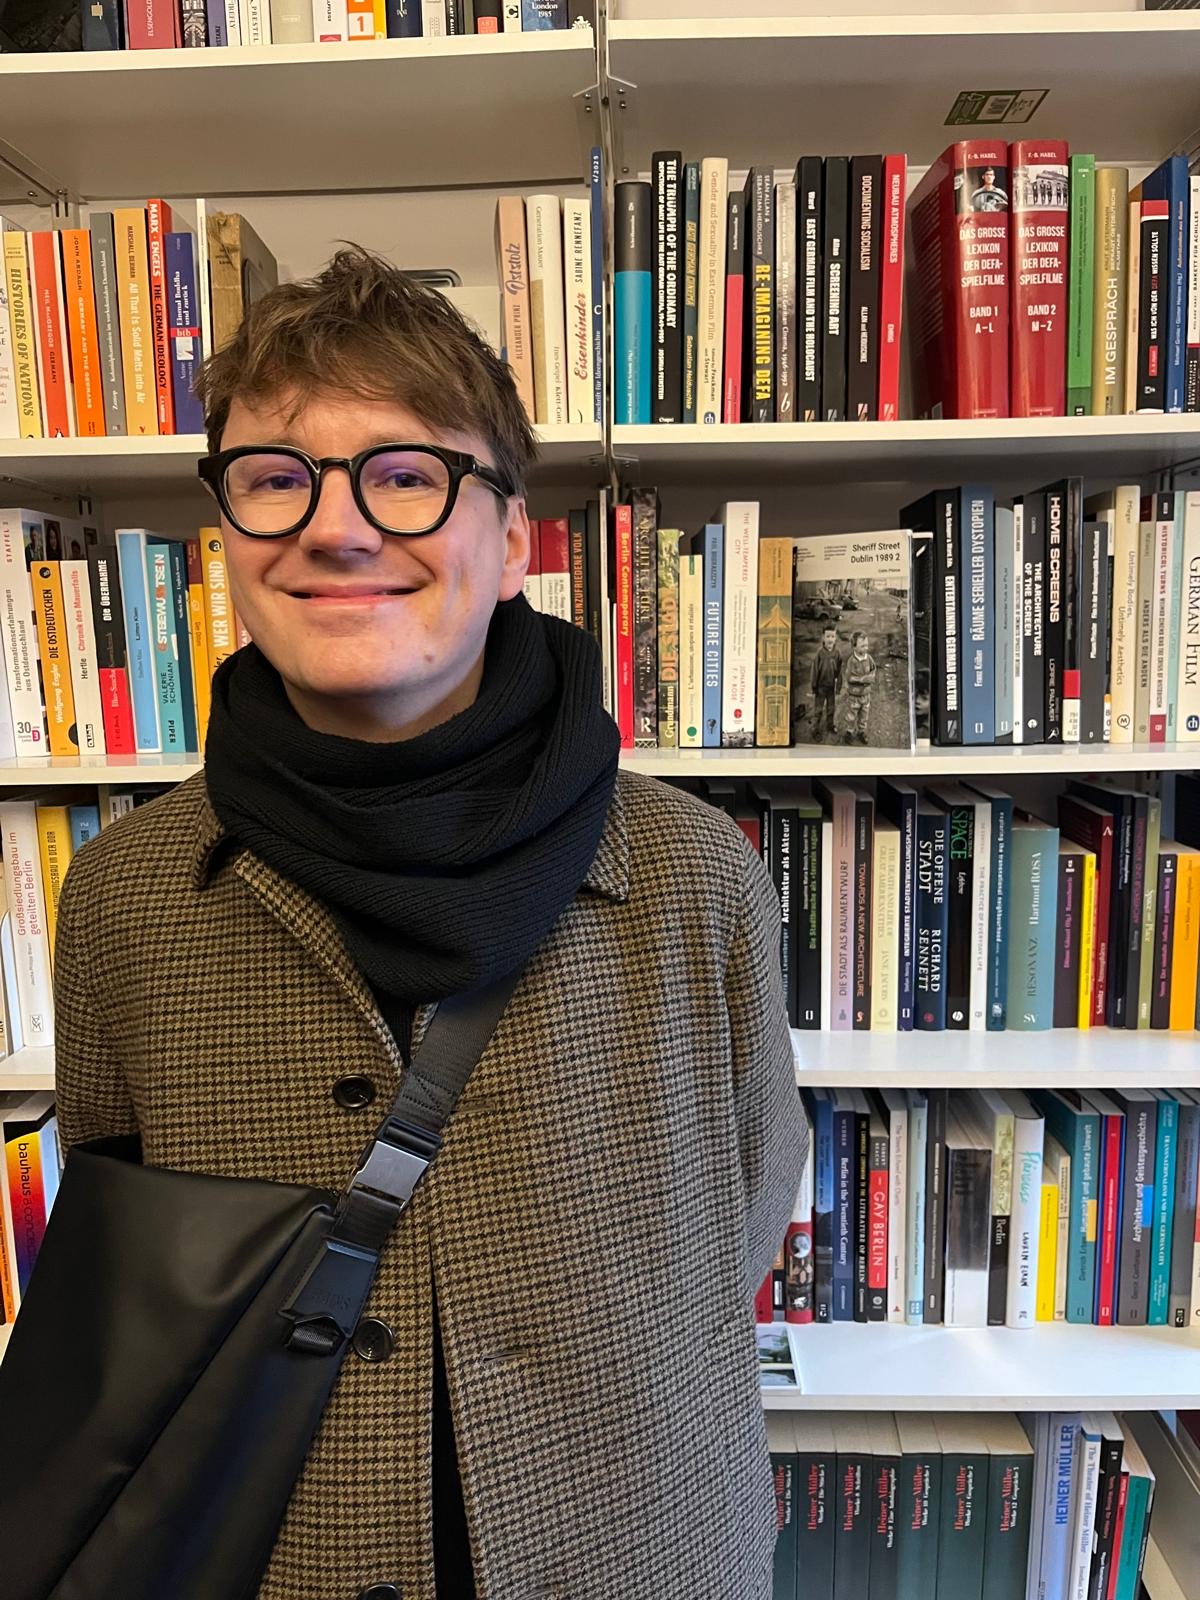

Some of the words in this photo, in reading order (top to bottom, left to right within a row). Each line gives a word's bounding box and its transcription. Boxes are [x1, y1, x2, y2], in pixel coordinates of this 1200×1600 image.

[532, 2, 558, 10] London
[356, 15, 364, 32] 1
[667, 159, 677, 181] THE
[667, 183, 677, 232] TRIUMPH
[807, 191, 816, 209] Ward
[149, 203, 160, 233] MARX
[536, 206, 544, 245] Generation
[805, 218, 816, 239] EAST
[959, 228, 976, 238] DAS
[977, 226, 1006, 238] GROSSE
[1019, 226, 1037, 238] DAS
[1038, 226, 1065, 238] GROSSE
[667, 234, 677, 248] OF
[832, 238, 840, 256] Allan
[967, 243, 1000, 254] LEXIKON
[1026, 241, 1059, 254] LEXIKON
[1151, 231, 1159, 253] SOLLTE
[151, 241, 162, 277] ENGELS
[537, 246, 545, 269] Mauer
[667, 250, 677, 270] THE
[805, 240, 816, 275] GERMAN
[964, 259, 980, 270] DER
[980, 258, 1004, 270] DEFA-
[1022, 258, 1040, 270] DER
[1041, 258, 1063, 270] DEFA-
[1151, 253, 1159, 274] WISSEN
[153, 284, 162, 301] THE
[805, 277, 816, 296] FILM
[829, 263, 840, 315] SCREENING
[961, 274, 1006, 287] SPIELFILME
[1019, 273, 1064, 286] SPIELFILME
[10, 268, 27, 340] HISTORIES
[667, 272, 677, 328] ORDINARY
[805, 297, 815, 315] AND
[970, 306, 991, 318] BAND
[993, 306, 998, 317] 1
[1028, 305, 1048, 317] BAND
[1050, 305, 1057, 316] 2
[155, 303, 165, 343] GERMAN
[755, 264, 771, 366] RE-IMAGINING
[805, 316, 815, 331] THE
[829, 317, 840, 335] ART
[1103, 278, 1118, 362] GESPRÄCH
[1151, 316, 1159, 327] ICH
[1151, 327, 1159, 340] WAS
[17, 342, 28, 359] OF
[805, 333, 815, 382] HOLOCAUST
[157, 344, 168, 389] IDEOLOGY
[1105, 366, 1117, 385] IM
[20, 361, 34, 417] NATIONS
[755, 369, 770, 400] DEFA
[1050, 496, 1061, 544] HOME
[621, 532, 630, 563] Berlin
[850, 555, 874, 564] Dublin
[875, 553, 894, 563] 1989
[895, 553, 900, 562] 2
[852, 543, 877, 553] Sheriff
[877, 542, 901, 552] Street
[208, 561, 226, 589] SIND
[1024, 562, 1032, 575] OF
[1034, 562, 1042, 581] THE
[1125, 550, 1136, 587] Untimely
[70, 570, 83, 609] Mauerfalls
[1024, 577, 1032, 596] THE
[1050, 548, 1061, 623] SCREENS
[1187, 555, 1200, 635] GERMAN
[209, 590, 228, 617] WIR
[620, 565, 631, 637] Contemporary
[944, 575, 956, 636] ENTERTAINING
[1125, 587, 1135, 618] Bodies,
[1142, 599, 1150, 627] ANDERS
[42, 588, 58, 645] OSTDEUTSCHEN
[74, 609, 83, 623] des
[1024, 599, 1032, 637] SCREEN
[1034, 583, 1042, 656] ARCHITECTURE
[1115, 605, 1127, 642] Untimely
[5, 589, 24, 692] Transformationserfahrungen
[76, 623, 86, 652] Chronik
[212, 619, 230, 648] WER
[17, 620, 31, 677] Ostdeutschland
[48, 646, 59, 659] DIE
[945, 637, 956, 673] GERMAN
[1141, 645, 1149, 658] DIE
[50, 663, 60, 687] Engler
[79, 657, 89, 680] Hertle
[1115, 644, 1125, 686] Aesthetics
[1140, 659, 1148, 688] ANDERN
[1185, 643, 1200, 686] FILM
[23, 678, 32, 692] aus
[160, 672, 169, 704] VALERIE
[165, 662, 177, 704] SCHÖNIAN
[946, 674, 957, 711] CULTURE
[53, 688, 65, 724] Wolfgang
[17, 721, 32, 734] 30
[167, 720, 176, 744] PIPER
[8, 831, 18, 845] im
[781, 818, 791, 854] Akteur?
[934, 829, 944, 853] DIE
[950, 809, 968, 860] SPACE
[24, 860, 35, 889] Berlin
[781, 856, 790, 869] als
[919, 840, 931, 893] STADT
[996, 854, 1004, 896] transnational
[1029, 852, 1041, 883] ROSA
[10, 846, 28, 936] Großsiedlungsbau
[858, 863, 866, 905] TOWARDS
[934, 854, 943, 904] OFFENE
[781, 871, 790, 923] Architektur
[839, 860, 848, 933] RAUMENTWURF
[1028, 883, 1040, 925] Hartmut
[25, 890, 42, 936] geteilten
[858, 912, 866, 932] NEW
[995, 896, 1003, 943] neighbourhood
[839, 934, 848, 950] ALS
[838, 951, 848, 979] STADT
[857, 933, 866, 997] ARCHITECTURE
[918, 928, 929, 992] SENNETT
[930, 929, 941, 992] RICHARD
[1027, 937, 1038, 997] RESONANZ
[1098, 942, 1106, 982] Atmosphären
[838, 981, 847, 996] DIE
[1096, 989, 1104, 1015] Schmitz
[1135, 1112, 1148, 1182] Geistesgeschichte
[873, 1191, 885, 1217] GAY
[1135, 1183, 1144, 1198] und
[1132, 1198, 1144, 1243] Architektur
[873, 1222, 885, 1266] BERLIN
[1055, 1424, 1074, 1477] MÜLLER
[1088, 1446, 1097, 1460] The
[1085, 1462, 1096, 1490] Theater
[1055, 1480, 1070, 1525] HEINER
[1085, 1492, 1094, 1501] of
[1082, 1502, 1093, 1527] Heiner
[1080, 1528, 1091, 1553] Müller
[1077, 1565, 1087, 1587] Jonathan
